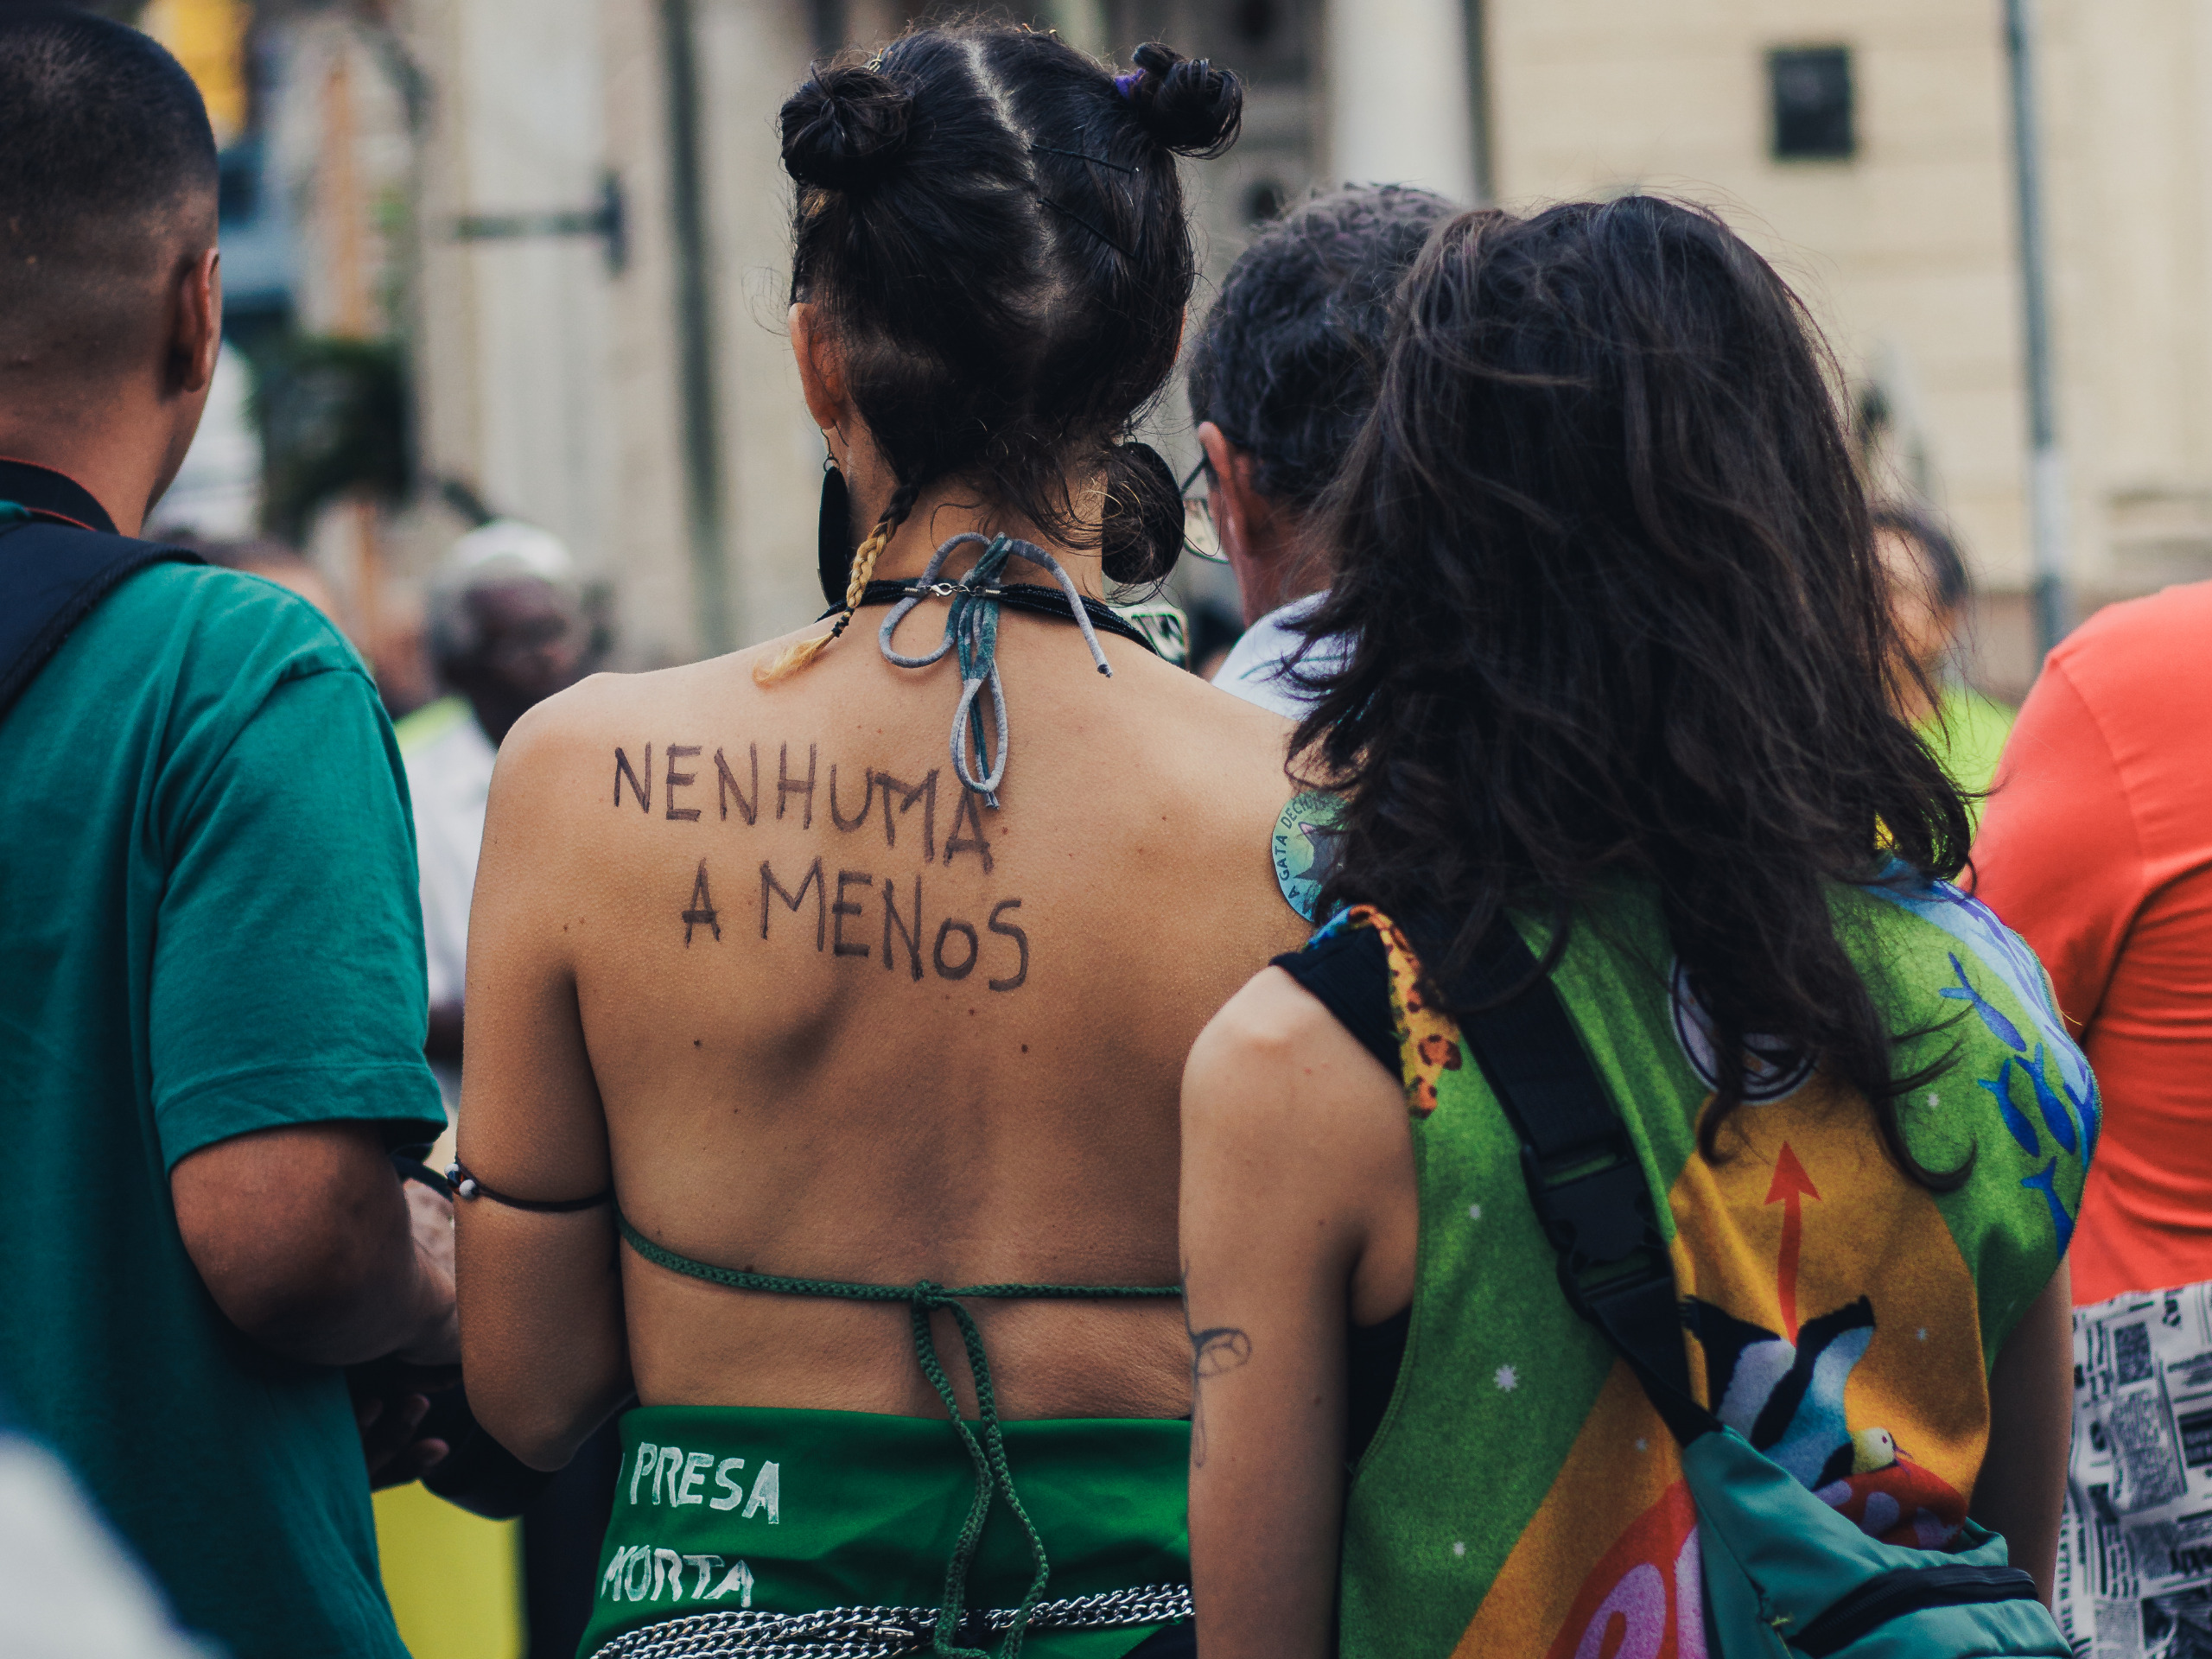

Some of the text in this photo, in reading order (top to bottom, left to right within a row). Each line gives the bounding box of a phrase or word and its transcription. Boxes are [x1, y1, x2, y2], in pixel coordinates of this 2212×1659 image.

[613, 741, 995, 874] NENHUMA
[1274, 835, 1290, 881] GATA
[1288, 886, 1300, 899] A
[681, 856, 1029, 993] A MENOS
[630, 1441, 779, 1524] PRESA
[601, 1545, 754, 1608] MORTA
